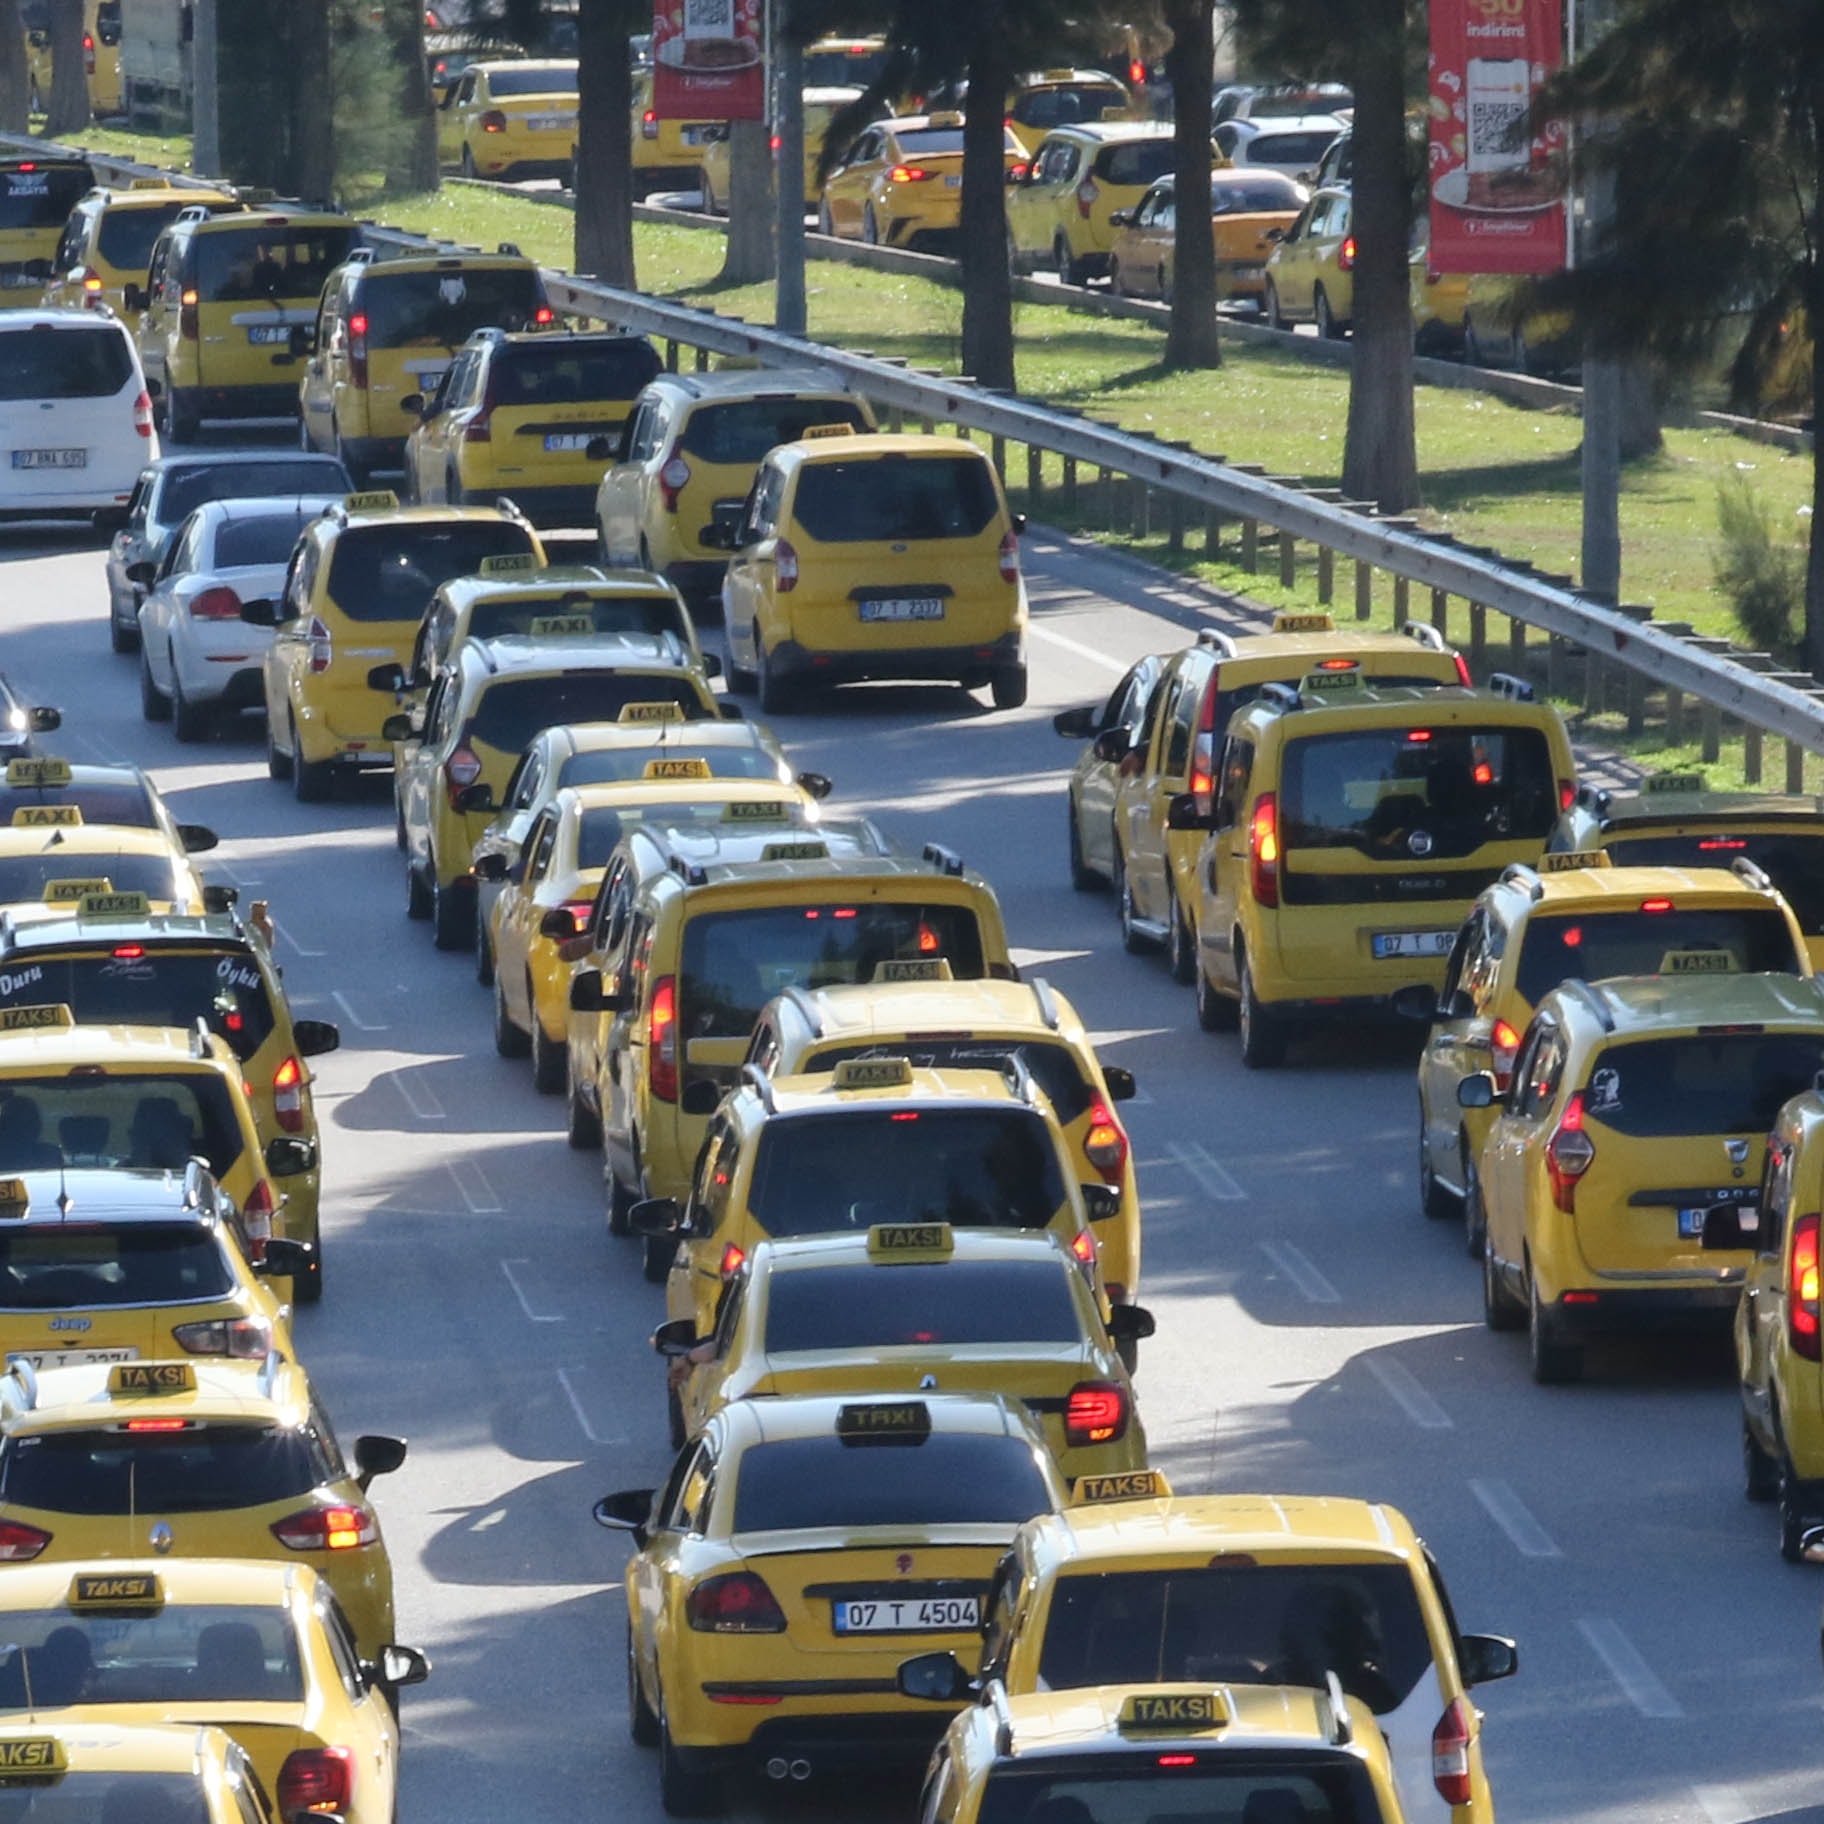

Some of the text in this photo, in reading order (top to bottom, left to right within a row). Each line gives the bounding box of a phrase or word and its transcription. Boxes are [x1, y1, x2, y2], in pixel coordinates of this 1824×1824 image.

[539, 621, 587, 633] TAXI
[23, 809, 74, 825] TAXI
[1384, 937, 1402, 953] 07
[849, 1602, 976, 1626] 07 T 4504
